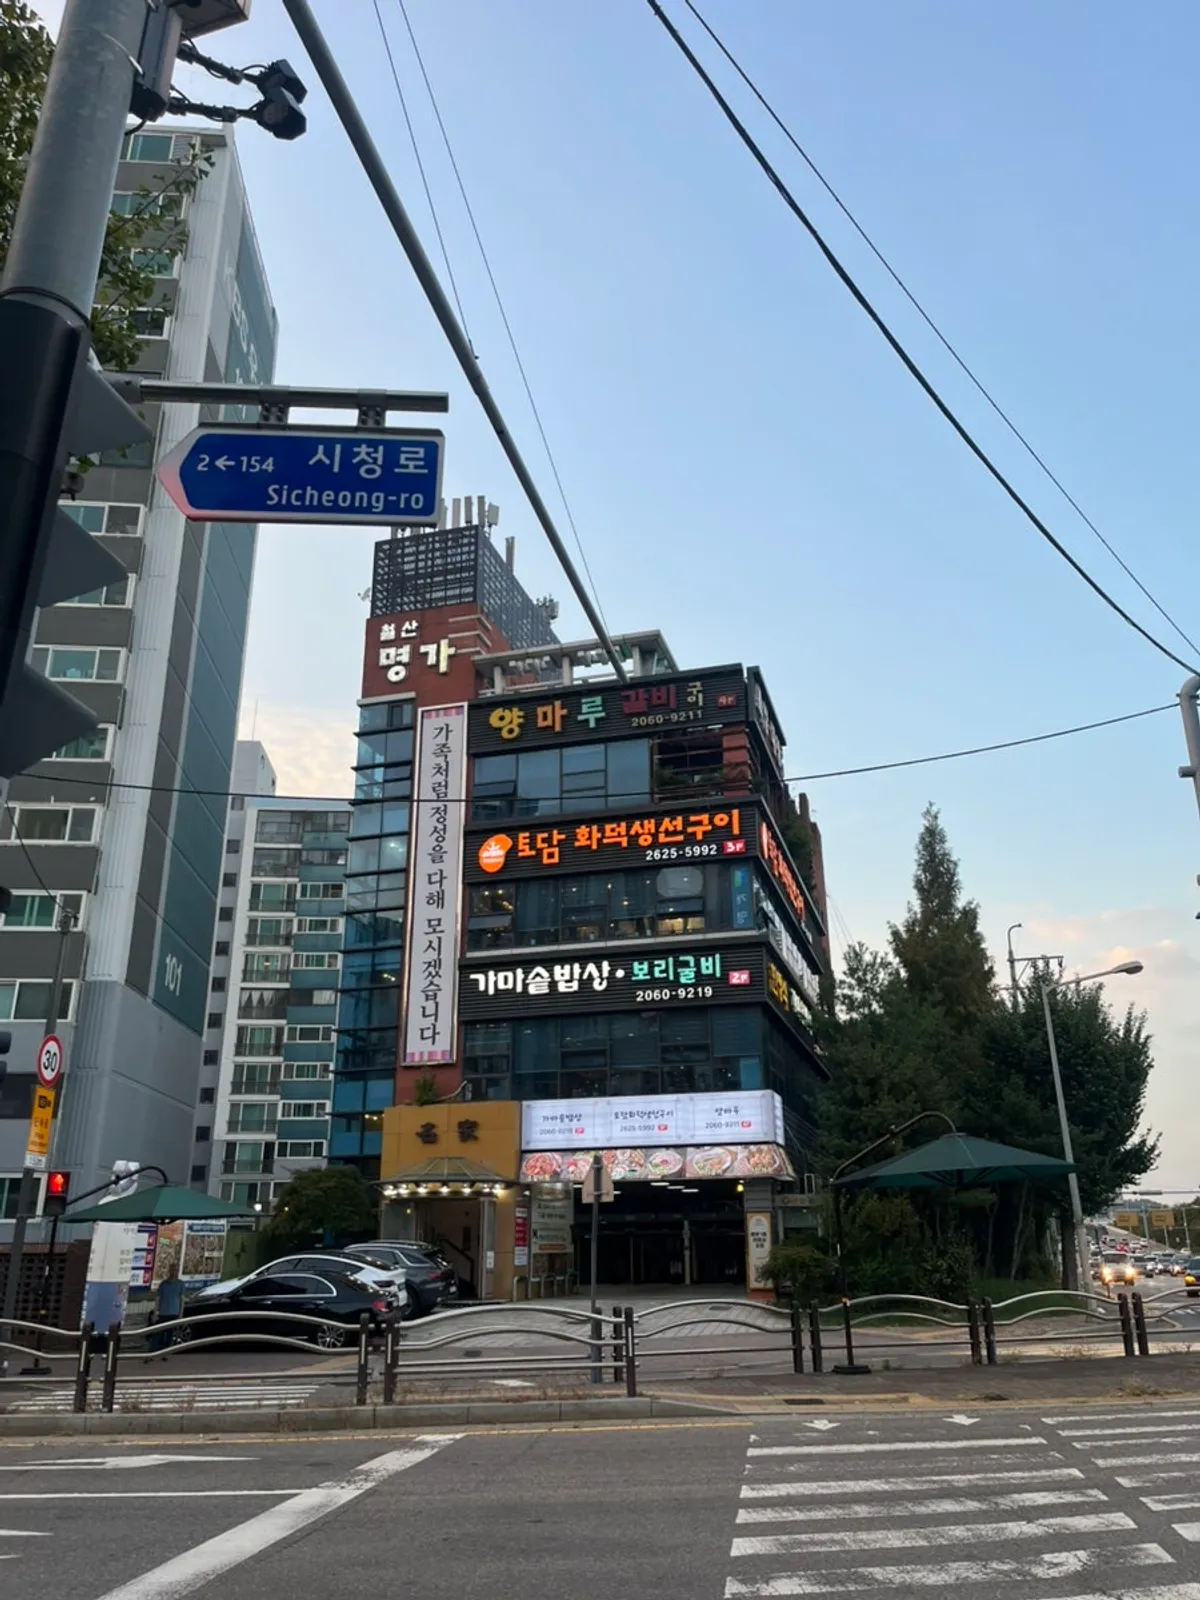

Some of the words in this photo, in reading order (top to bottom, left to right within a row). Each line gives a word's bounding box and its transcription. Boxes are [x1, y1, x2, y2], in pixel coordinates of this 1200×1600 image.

[197, 455, 209, 472] 2
[241, 456, 275, 474] 154
[308, 444, 429, 479] 시청로
[266, 485, 425, 512] Sicheong-ro
[380, 620, 419, 642] 철산
[379, 638, 456, 683] 명가
[621, 684, 677, 714] 갈비
[631, 709, 703, 728] 2060-9211
[516, 829, 566, 865] 토담
[573, 809, 741, 850] 화덕생선구이
[725, 842, 744, 854] 3F
[645, 844, 718, 862] 2625-5992
[631, 953, 722, 985] 보리굴비
[731, 972, 748, 984] 2F
[419, 917, 446, 1046] 모시겠습니다
[635, 986, 713, 1002] 2060-9219
[42, 1050, 58, 1073] 30
